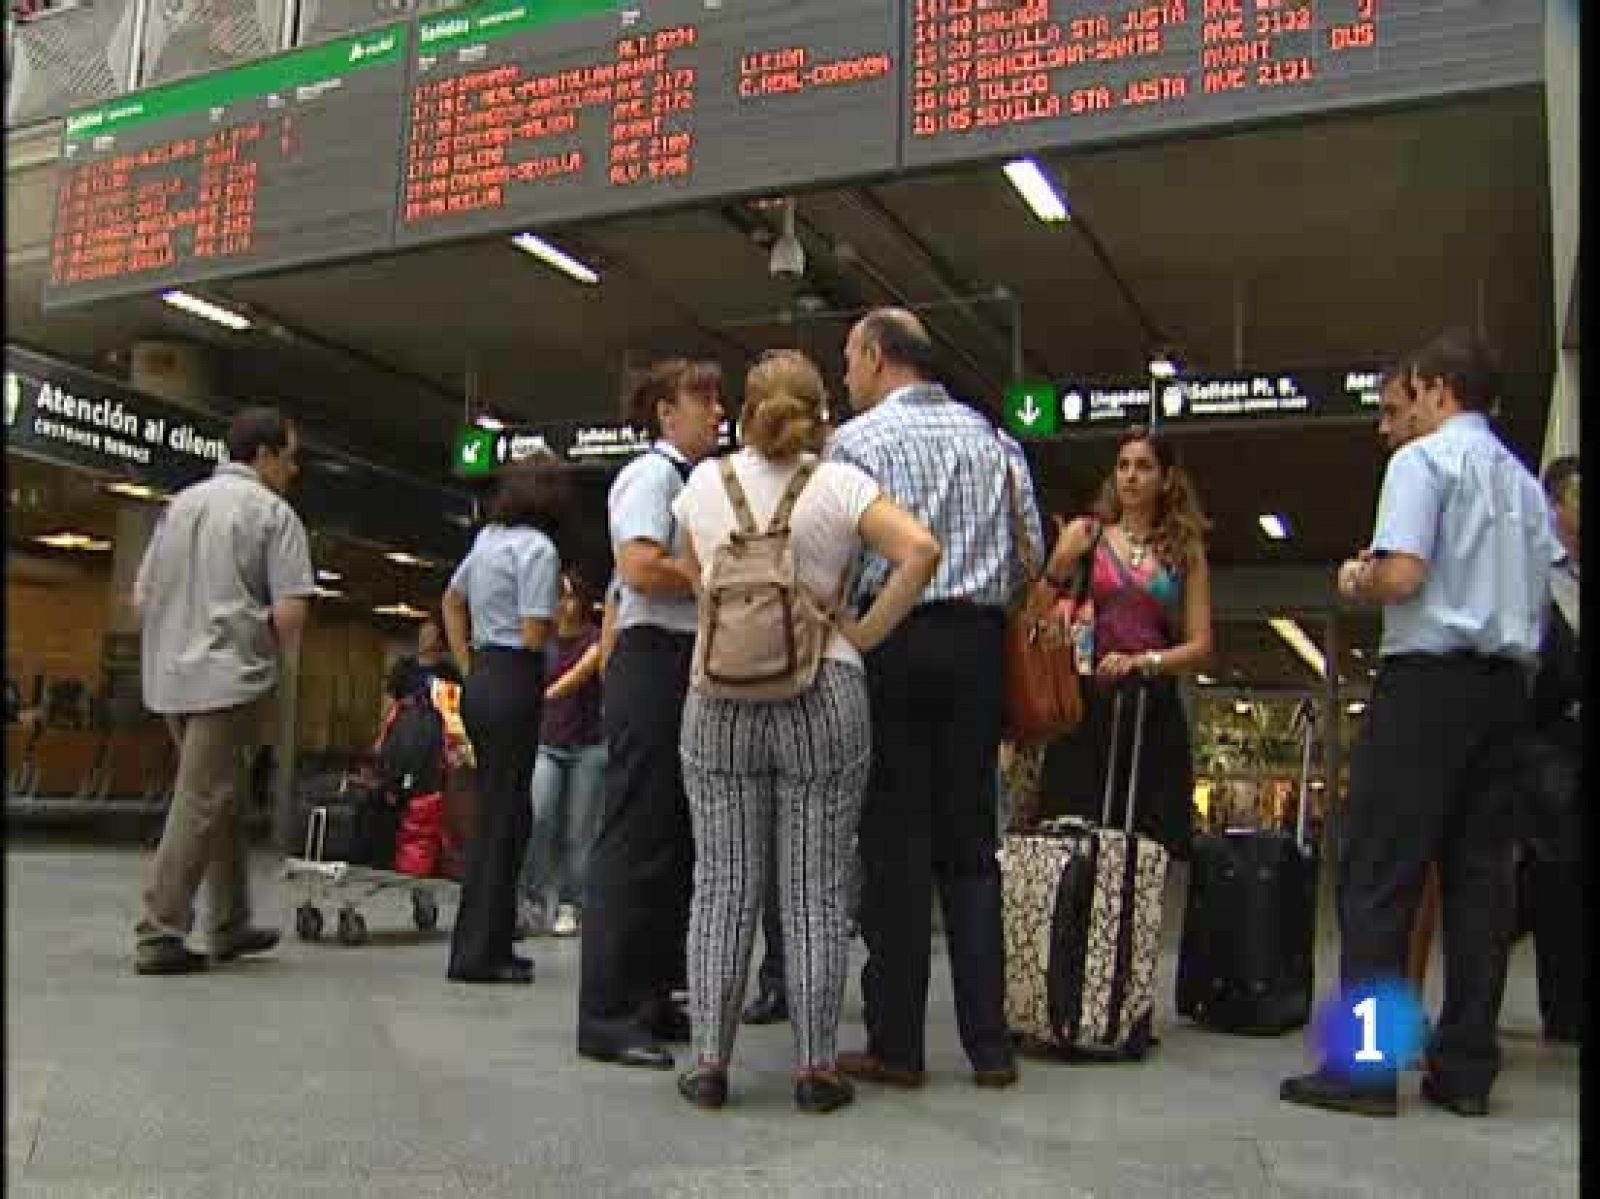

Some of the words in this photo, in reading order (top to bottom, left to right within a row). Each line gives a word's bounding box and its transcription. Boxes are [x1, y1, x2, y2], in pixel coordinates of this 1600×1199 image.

[977, 26, 1060, 53] SEVILLA
[977, 95, 1060, 126] SEVILLA
[1071, 85, 1109, 113] STA
[1122, 78, 1185, 105] JUSTA
[37, 382, 138, 438] Atención
[144, 418, 165, 444] al
